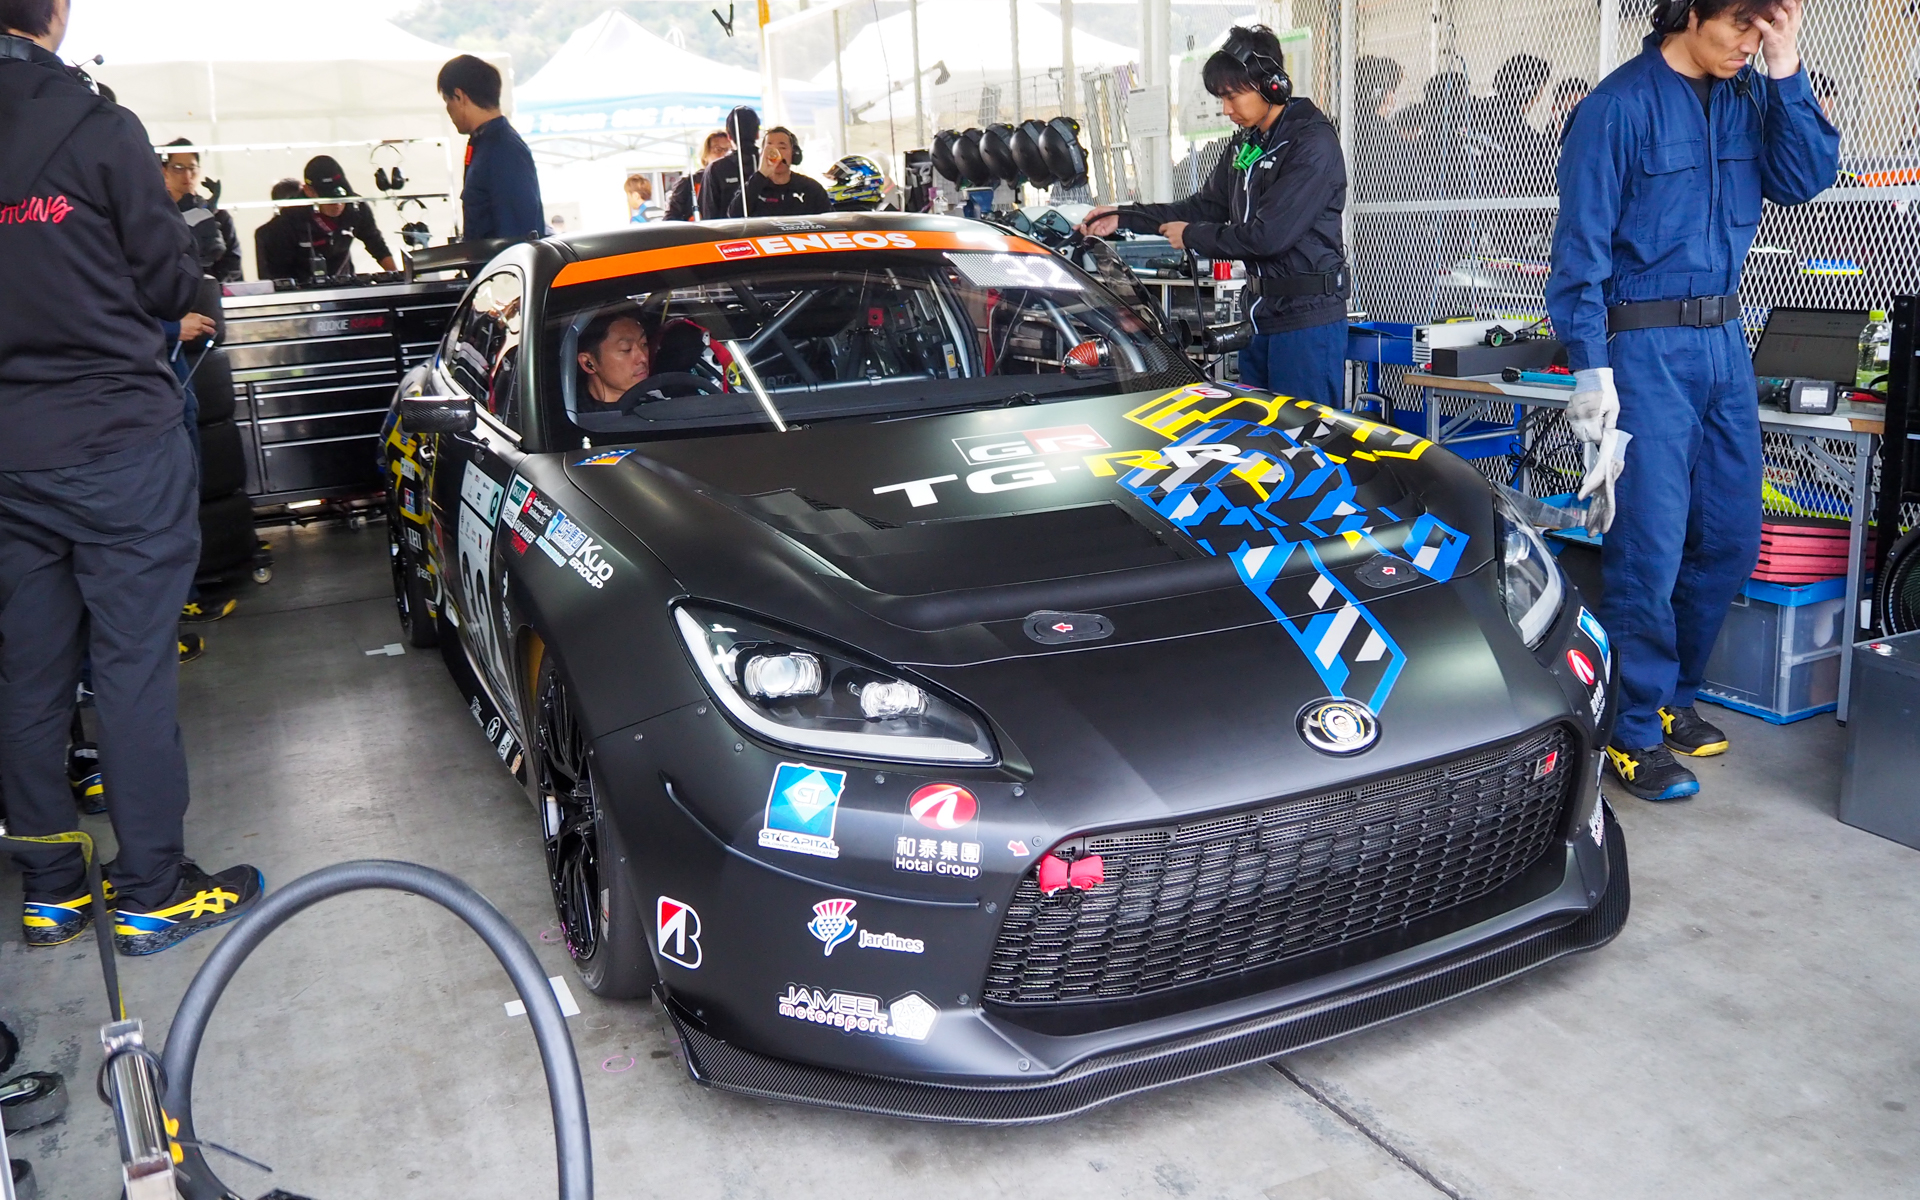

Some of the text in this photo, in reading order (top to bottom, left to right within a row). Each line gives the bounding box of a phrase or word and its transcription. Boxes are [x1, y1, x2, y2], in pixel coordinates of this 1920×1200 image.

[722, 232, 917, 254] ENEOS ENEOS
[992, 253, 1085, 290] 32
[316, 319, 349, 332] ROOKIE
[967, 433, 1108, 462] GR
[407, 527, 423, 551] IHI
[575, 537, 614, 582] KUO
[568, 557, 604, 589] GROUP
[793, 782, 829, 805] GT
[896, 836, 981, 864] 和泰集團
[895, 857, 979, 878] Hotai Group
[859, 930, 924, 952] Jardines
[779, 986, 888, 1020] JAMEEL
